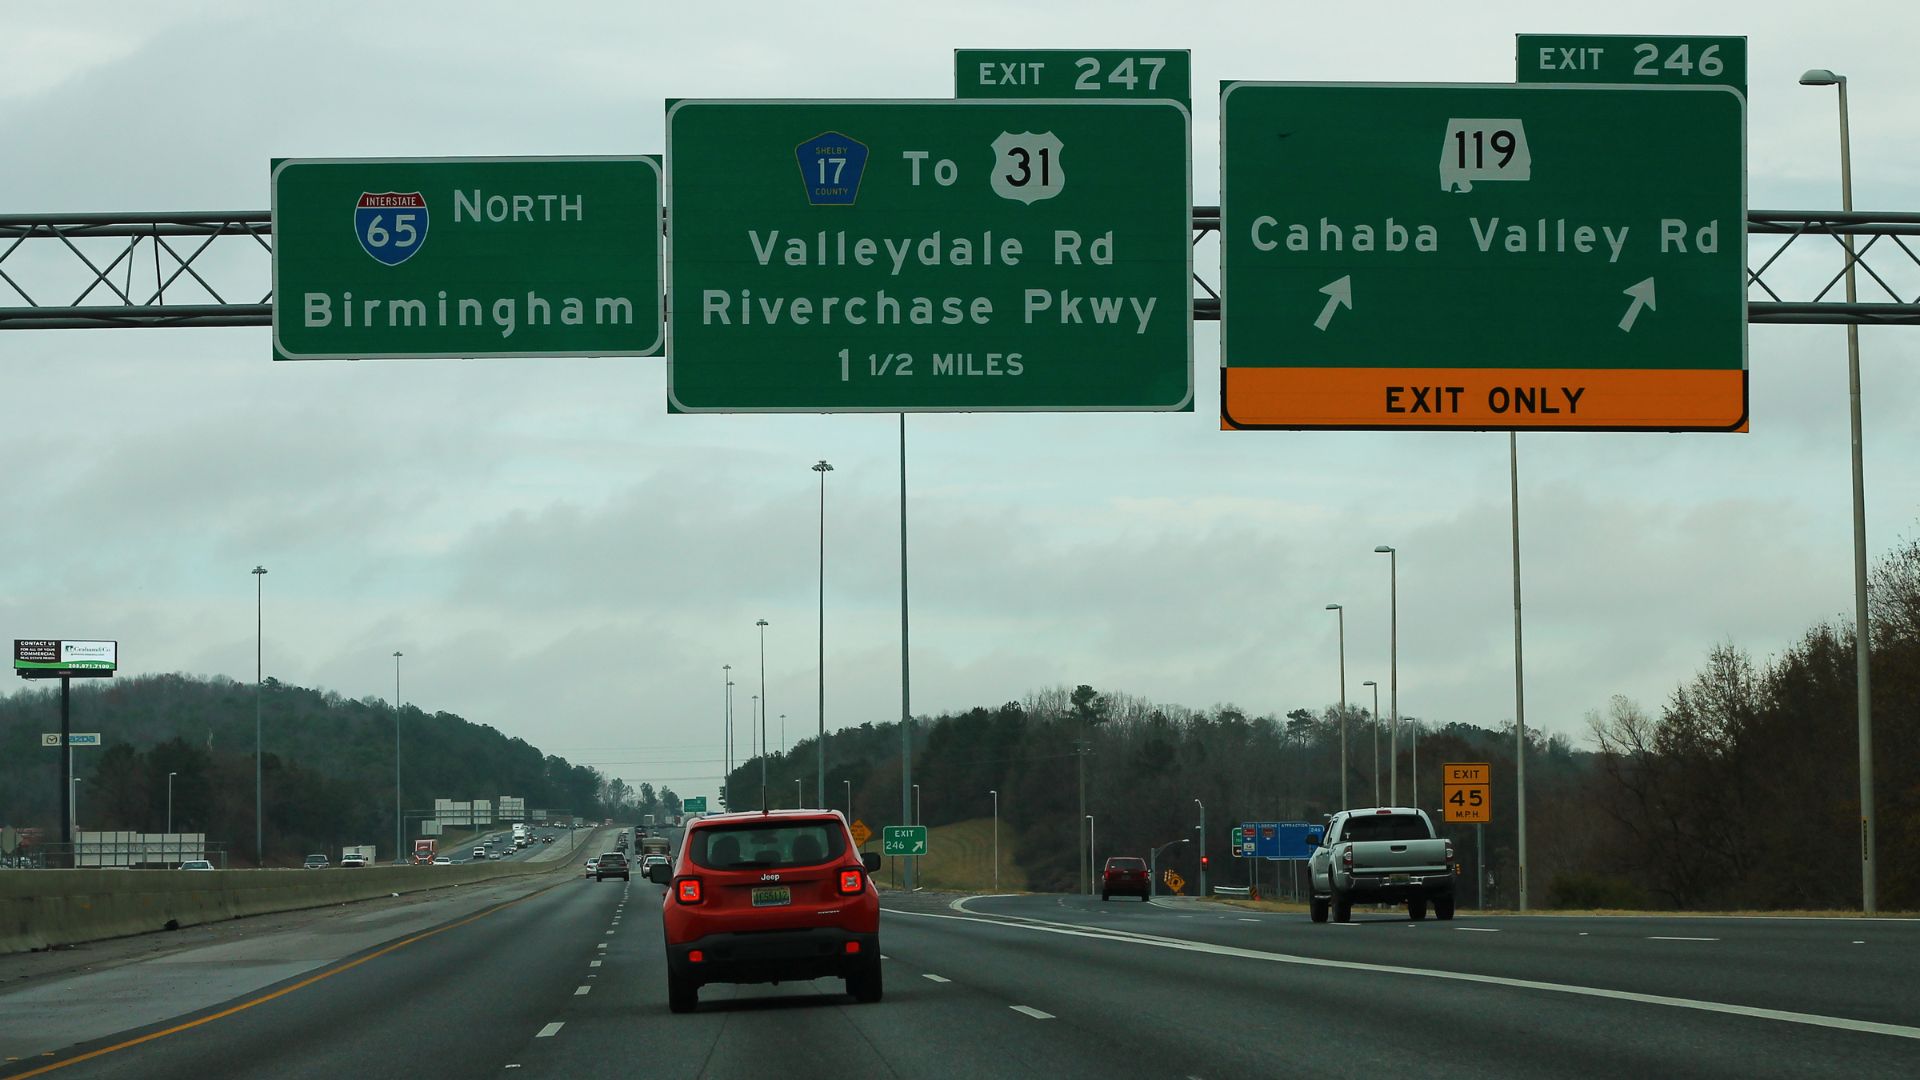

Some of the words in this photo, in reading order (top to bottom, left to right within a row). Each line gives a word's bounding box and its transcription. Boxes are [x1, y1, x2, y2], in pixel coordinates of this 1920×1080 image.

[979, 62, 1045, 85] EXIT
[1074, 56, 1166, 91] 247
[1539, 47, 1604, 70] EXIT
[1633, 43, 1724, 77] 246
[815, 146, 849, 155] SHELBY
[1455, 129, 1516, 169] 119
[817, 157, 847, 185] 17
[902, 150, 958, 187] To
[1005, 146, 1050, 188] 31
[366, 196, 417, 206] INTERSTATE
[454, 189, 583, 223] NORTH
[815, 187, 849, 196] COUNTY
[366, 213, 418, 248] 65
[1251, 215, 1438, 252] Cahaba
[1469, 217, 1630, 263] Valley
[1660, 218, 1719, 254] Rd
[747, 230, 1023, 276] Valleydale
[1054, 230, 1114, 266] Rd
[304, 290, 633, 339] Birmingham
[703, 288, 993, 325] Riverchase
[1024, 288, 1157, 335] Pkwy
[838, 348, 850, 382] 1
[868, 353, 913, 376] 1/2
[932, 352, 1024, 376] MILES
[1386, 386, 1465, 414] EXIT
[1488, 386, 1585, 414] ONLY
[1453, 769, 1480, 779] EXIT
[1449, 789, 1483, 807] 45
[885, 840, 905, 850] 246
[894, 829, 915, 838] EXIT
[760, 873, 780, 881] Jeep
